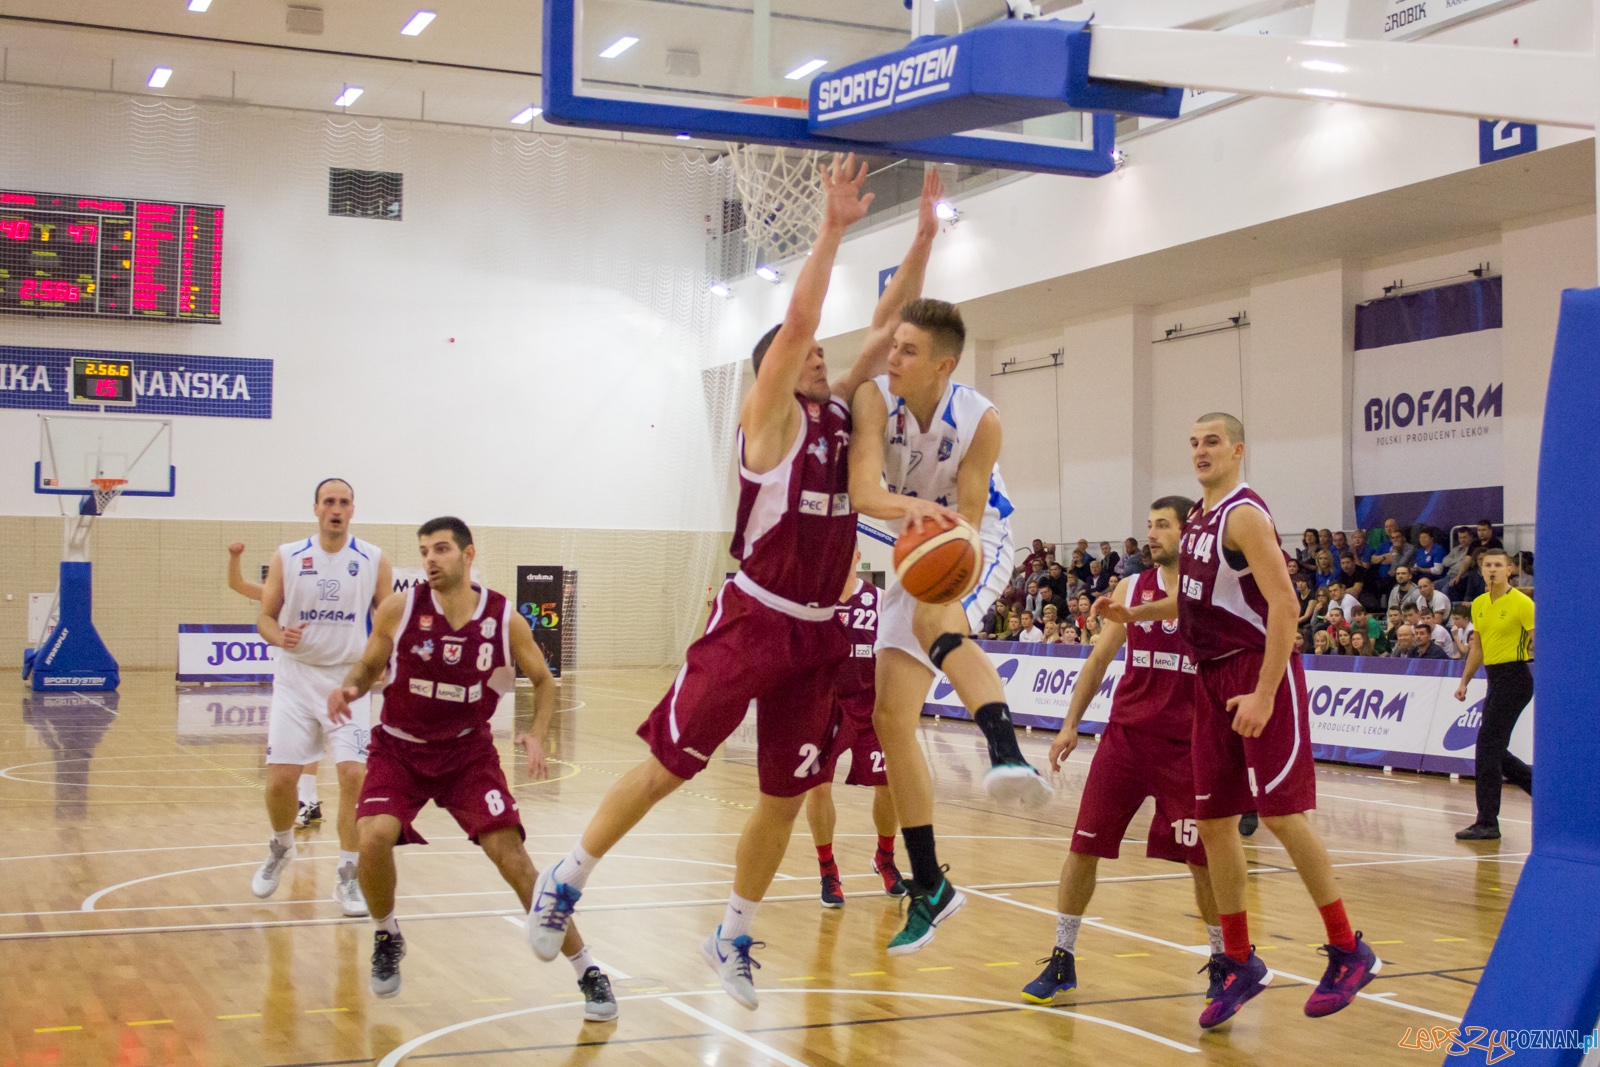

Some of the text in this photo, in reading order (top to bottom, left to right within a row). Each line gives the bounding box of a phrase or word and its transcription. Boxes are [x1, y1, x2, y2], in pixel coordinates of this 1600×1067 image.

[819, 45, 958, 111] SPORTSYSTEM
[0, 219, 31, 241] 40
[67, 224, 98, 244] 47
[85, 363, 129, 377] 2.56.6
[95, 379, 117, 397] 15
[1364, 382, 1503, 432] BIOFARM
[1376, 436, 1402, 446] POLSKI
[1406, 429, 1457, 443] PRODUCENT
[800, 498, 823, 511] PEC
[1194, 532, 1215, 563] 44
[316, 578, 341, 602] 12
[520, 602, 559, 631] 35
[852, 607, 878, 631] 22
[476, 642, 495, 672] 8
[1154, 658, 1176, 667] MPGK
[1032, 669, 1115, 699] BIOFM
[1318, 721, 1360, 733] PRODUCENT
[484, 788, 505, 817] 8
[1171, 818, 1199, 847] 15
